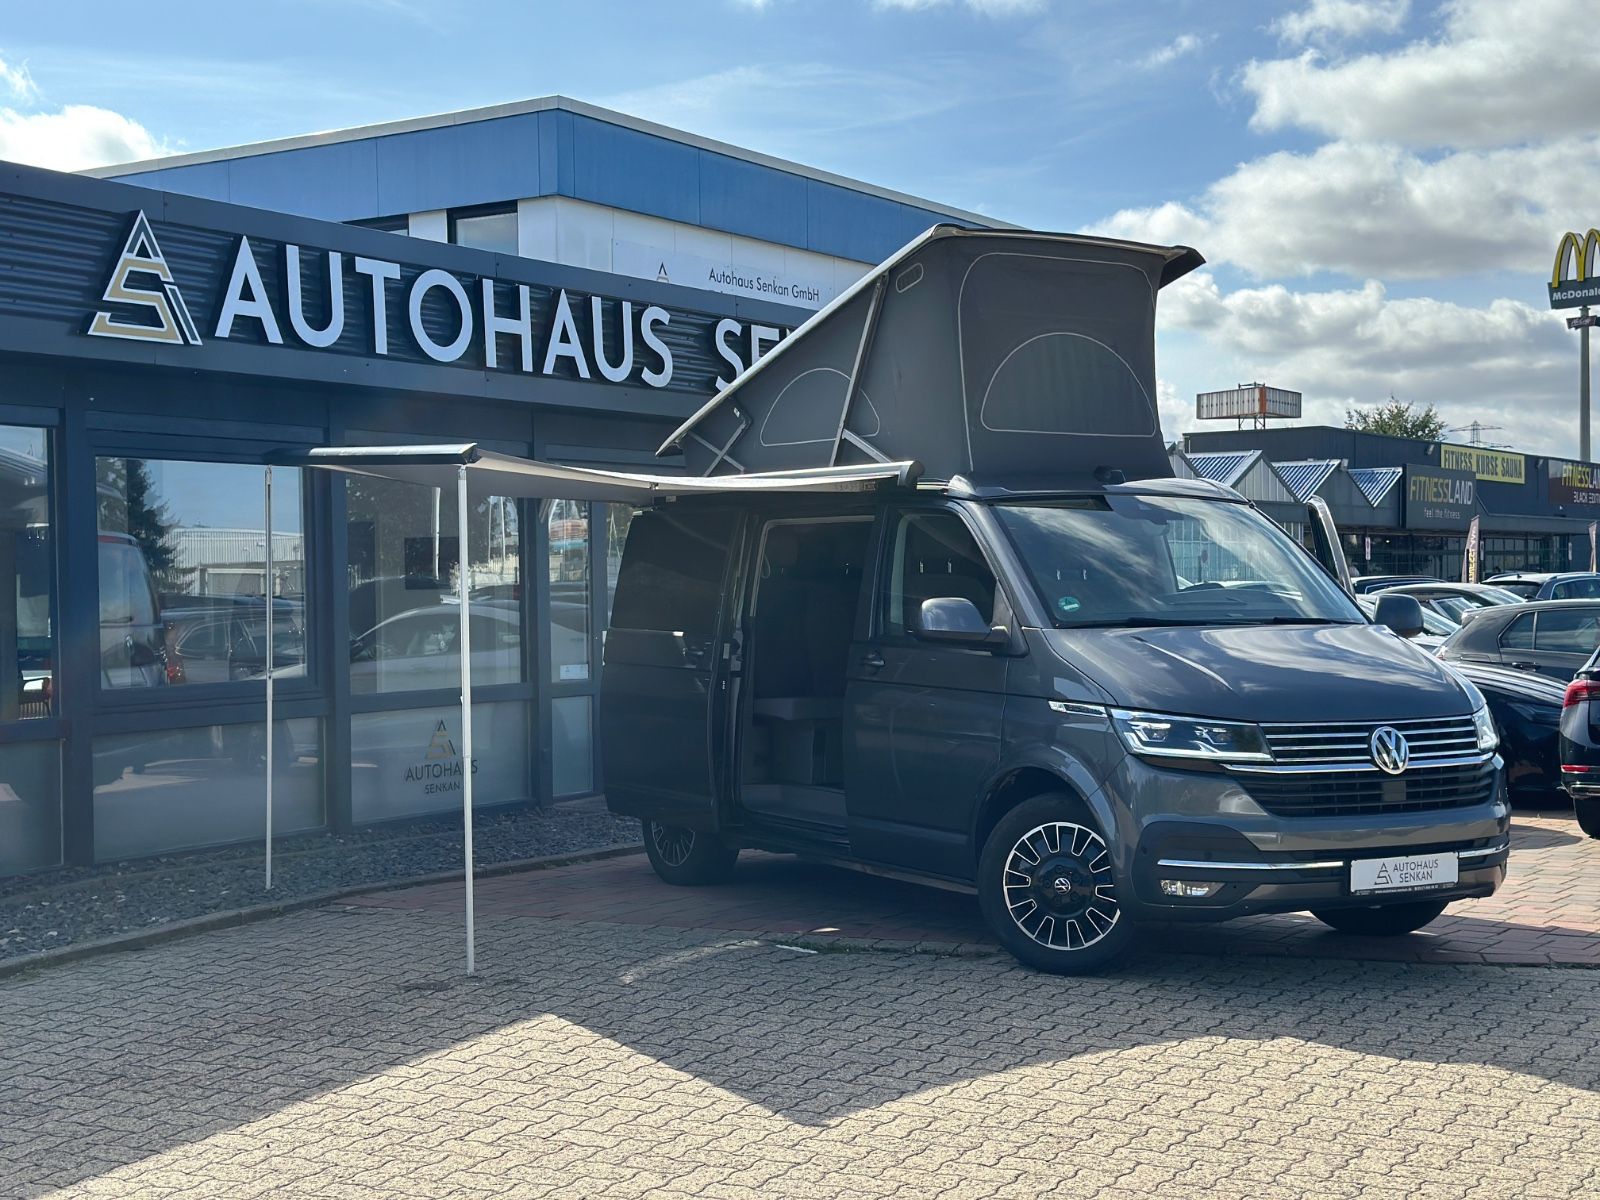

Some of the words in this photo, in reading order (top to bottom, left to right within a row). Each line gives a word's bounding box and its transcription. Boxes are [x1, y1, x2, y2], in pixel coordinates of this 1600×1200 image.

[709, 268, 754, 290] Autohaus
[756, 277, 789, 297] Senkan
[792, 284, 819, 302] GmbH
[215, 235, 674, 388] AUTOHAUS
[715, 318, 791, 392] SE
[1444, 450, 1473, 471] FITNESS
[1476, 454, 1498, 476] KURSE
[1501, 457, 1522, 479] SAUNA
[1409, 476, 1473, 505] FITNESSLAND
[405, 760, 478, 782] AUTOHAS
[425, 781, 460, 795] SENKAN
[1393, 860, 1439, 873] AUTOHAUS
[1399, 870, 1433, 883] SENKAN
